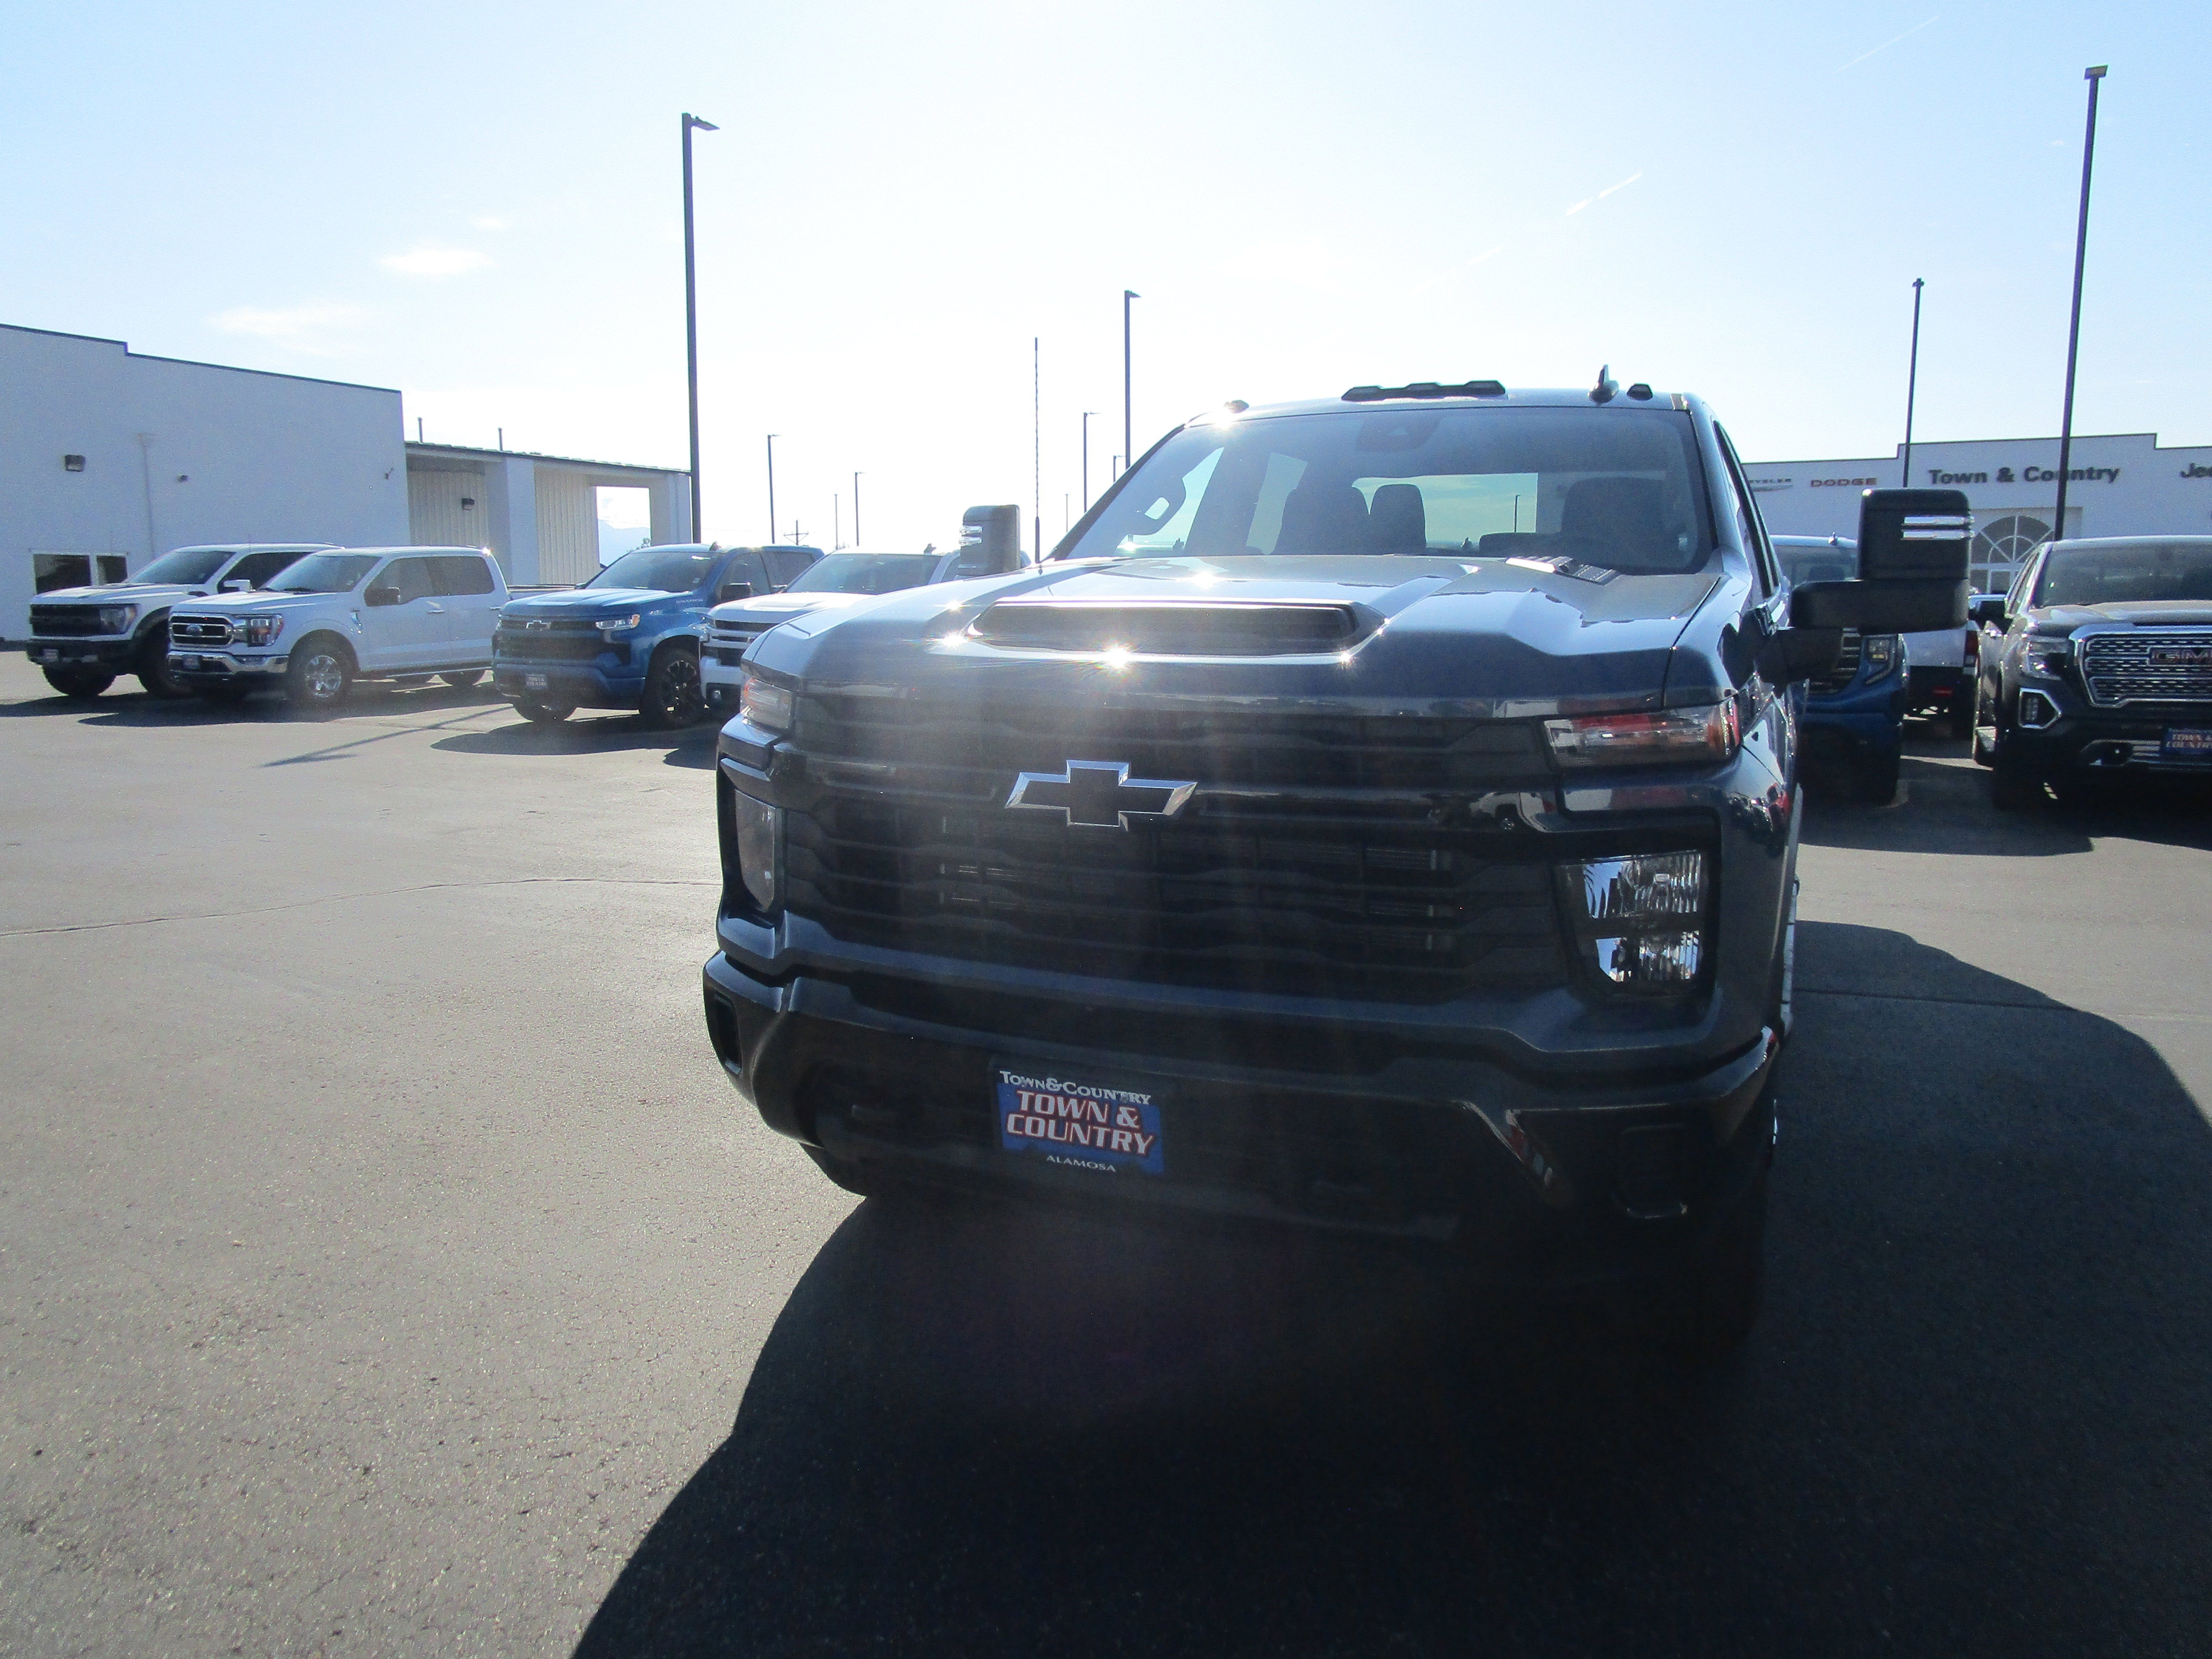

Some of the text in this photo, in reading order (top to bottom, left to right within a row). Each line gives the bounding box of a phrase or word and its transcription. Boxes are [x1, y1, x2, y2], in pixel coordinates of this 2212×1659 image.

[1811, 477, 1877, 487] DODGE
[1929, 469, 1988, 484] Town
[1997, 467, 2015, 482] &
[1016, 1090, 1140, 1129] TOWN &
[1007, 1113, 1154, 1155] COUNTRY
[1046, 1155, 1116, 1173] ALAMOSA
